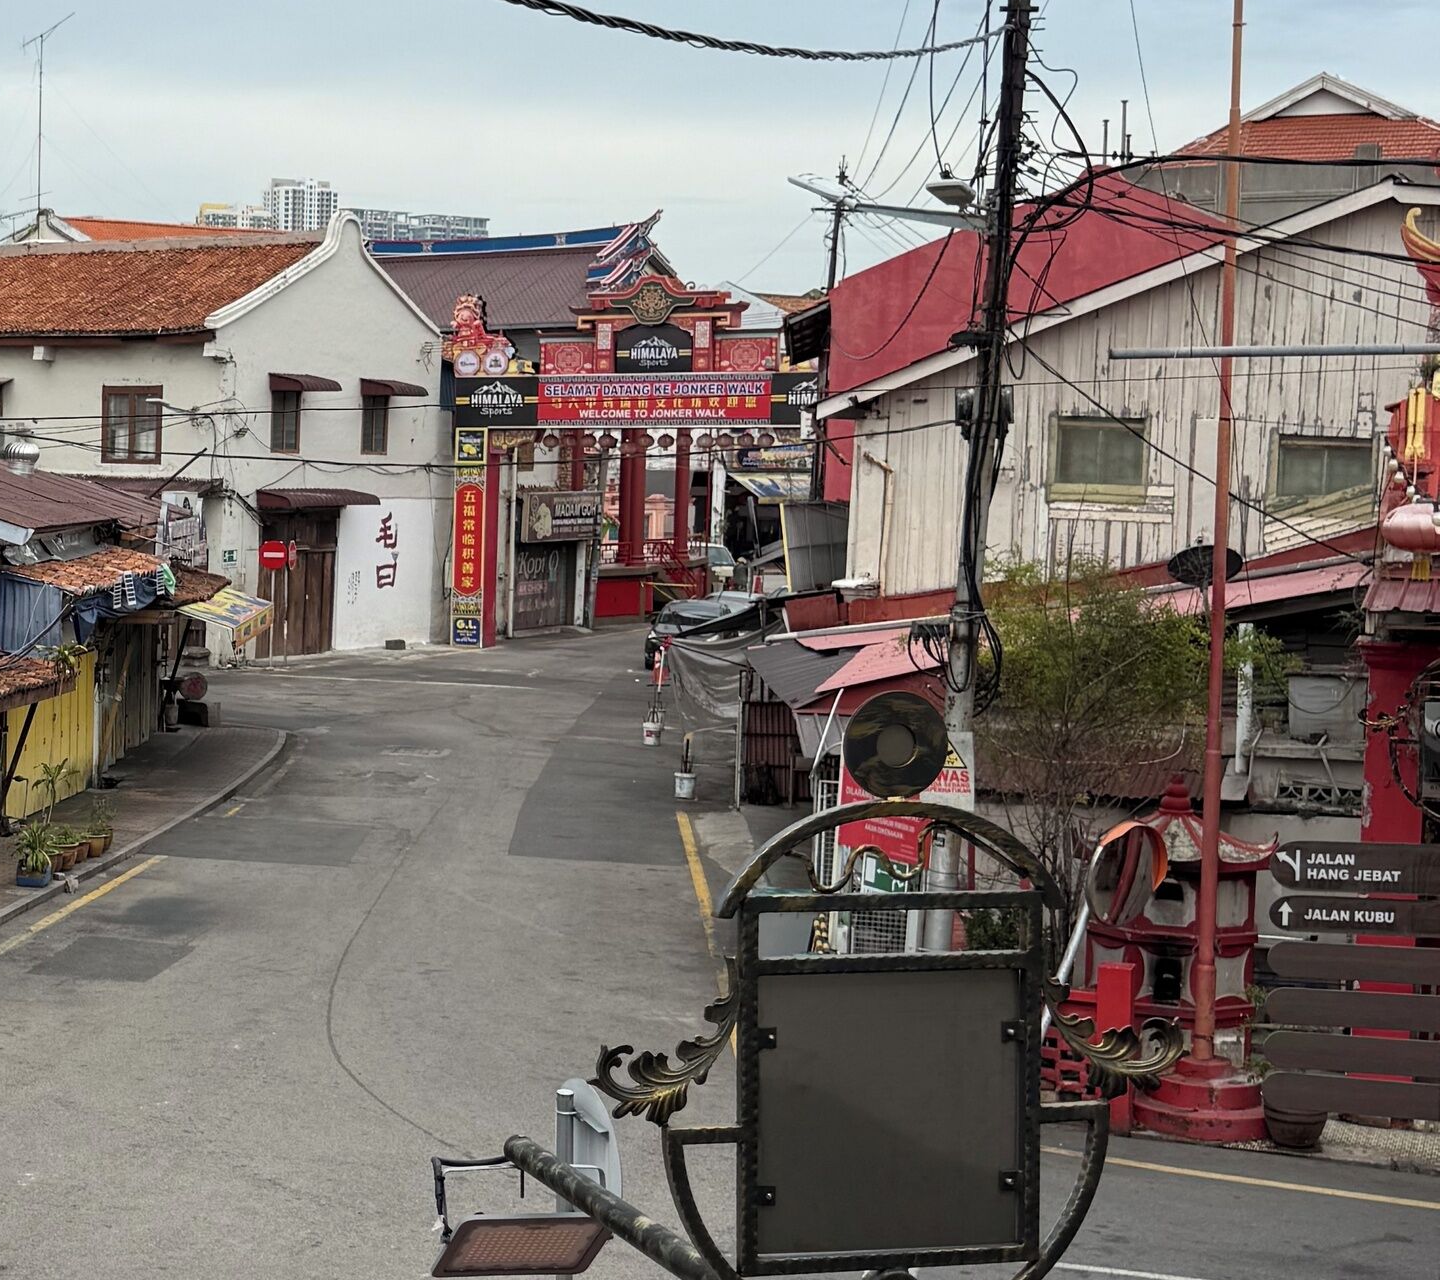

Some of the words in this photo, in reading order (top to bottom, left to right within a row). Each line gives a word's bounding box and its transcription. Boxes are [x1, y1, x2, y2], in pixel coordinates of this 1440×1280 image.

[630, 347, 678, 359] HIMALAYA
[545, 385, 599, 396] SELAMAT
[603, 384, 650, 395] DATANG
[654, 384, 669, 395] KE
[675, 384, 723, 395] JONKER
[727, 383, 764, 394] WALK
[471, 393, 523, 407] HIMALAYA
[579, 410, 631, 418] WELCOME
[634, 410, 647, 418] TO
[650, 410, 692, 418] JONKER
[555, 504, 580, 517] MADAM
[517, 551, 546, 580] Kopi
[939, 770, 970, 782] WAS
[1307, 853, 1355, 865] JALAN
[1307, 868, 1349, 880] HANG
[1353, 870, 1401, 882] JEBAT
[1304, 909, 1350, 922] JALAN
[1354, 910, 1395, 924] KUBU
